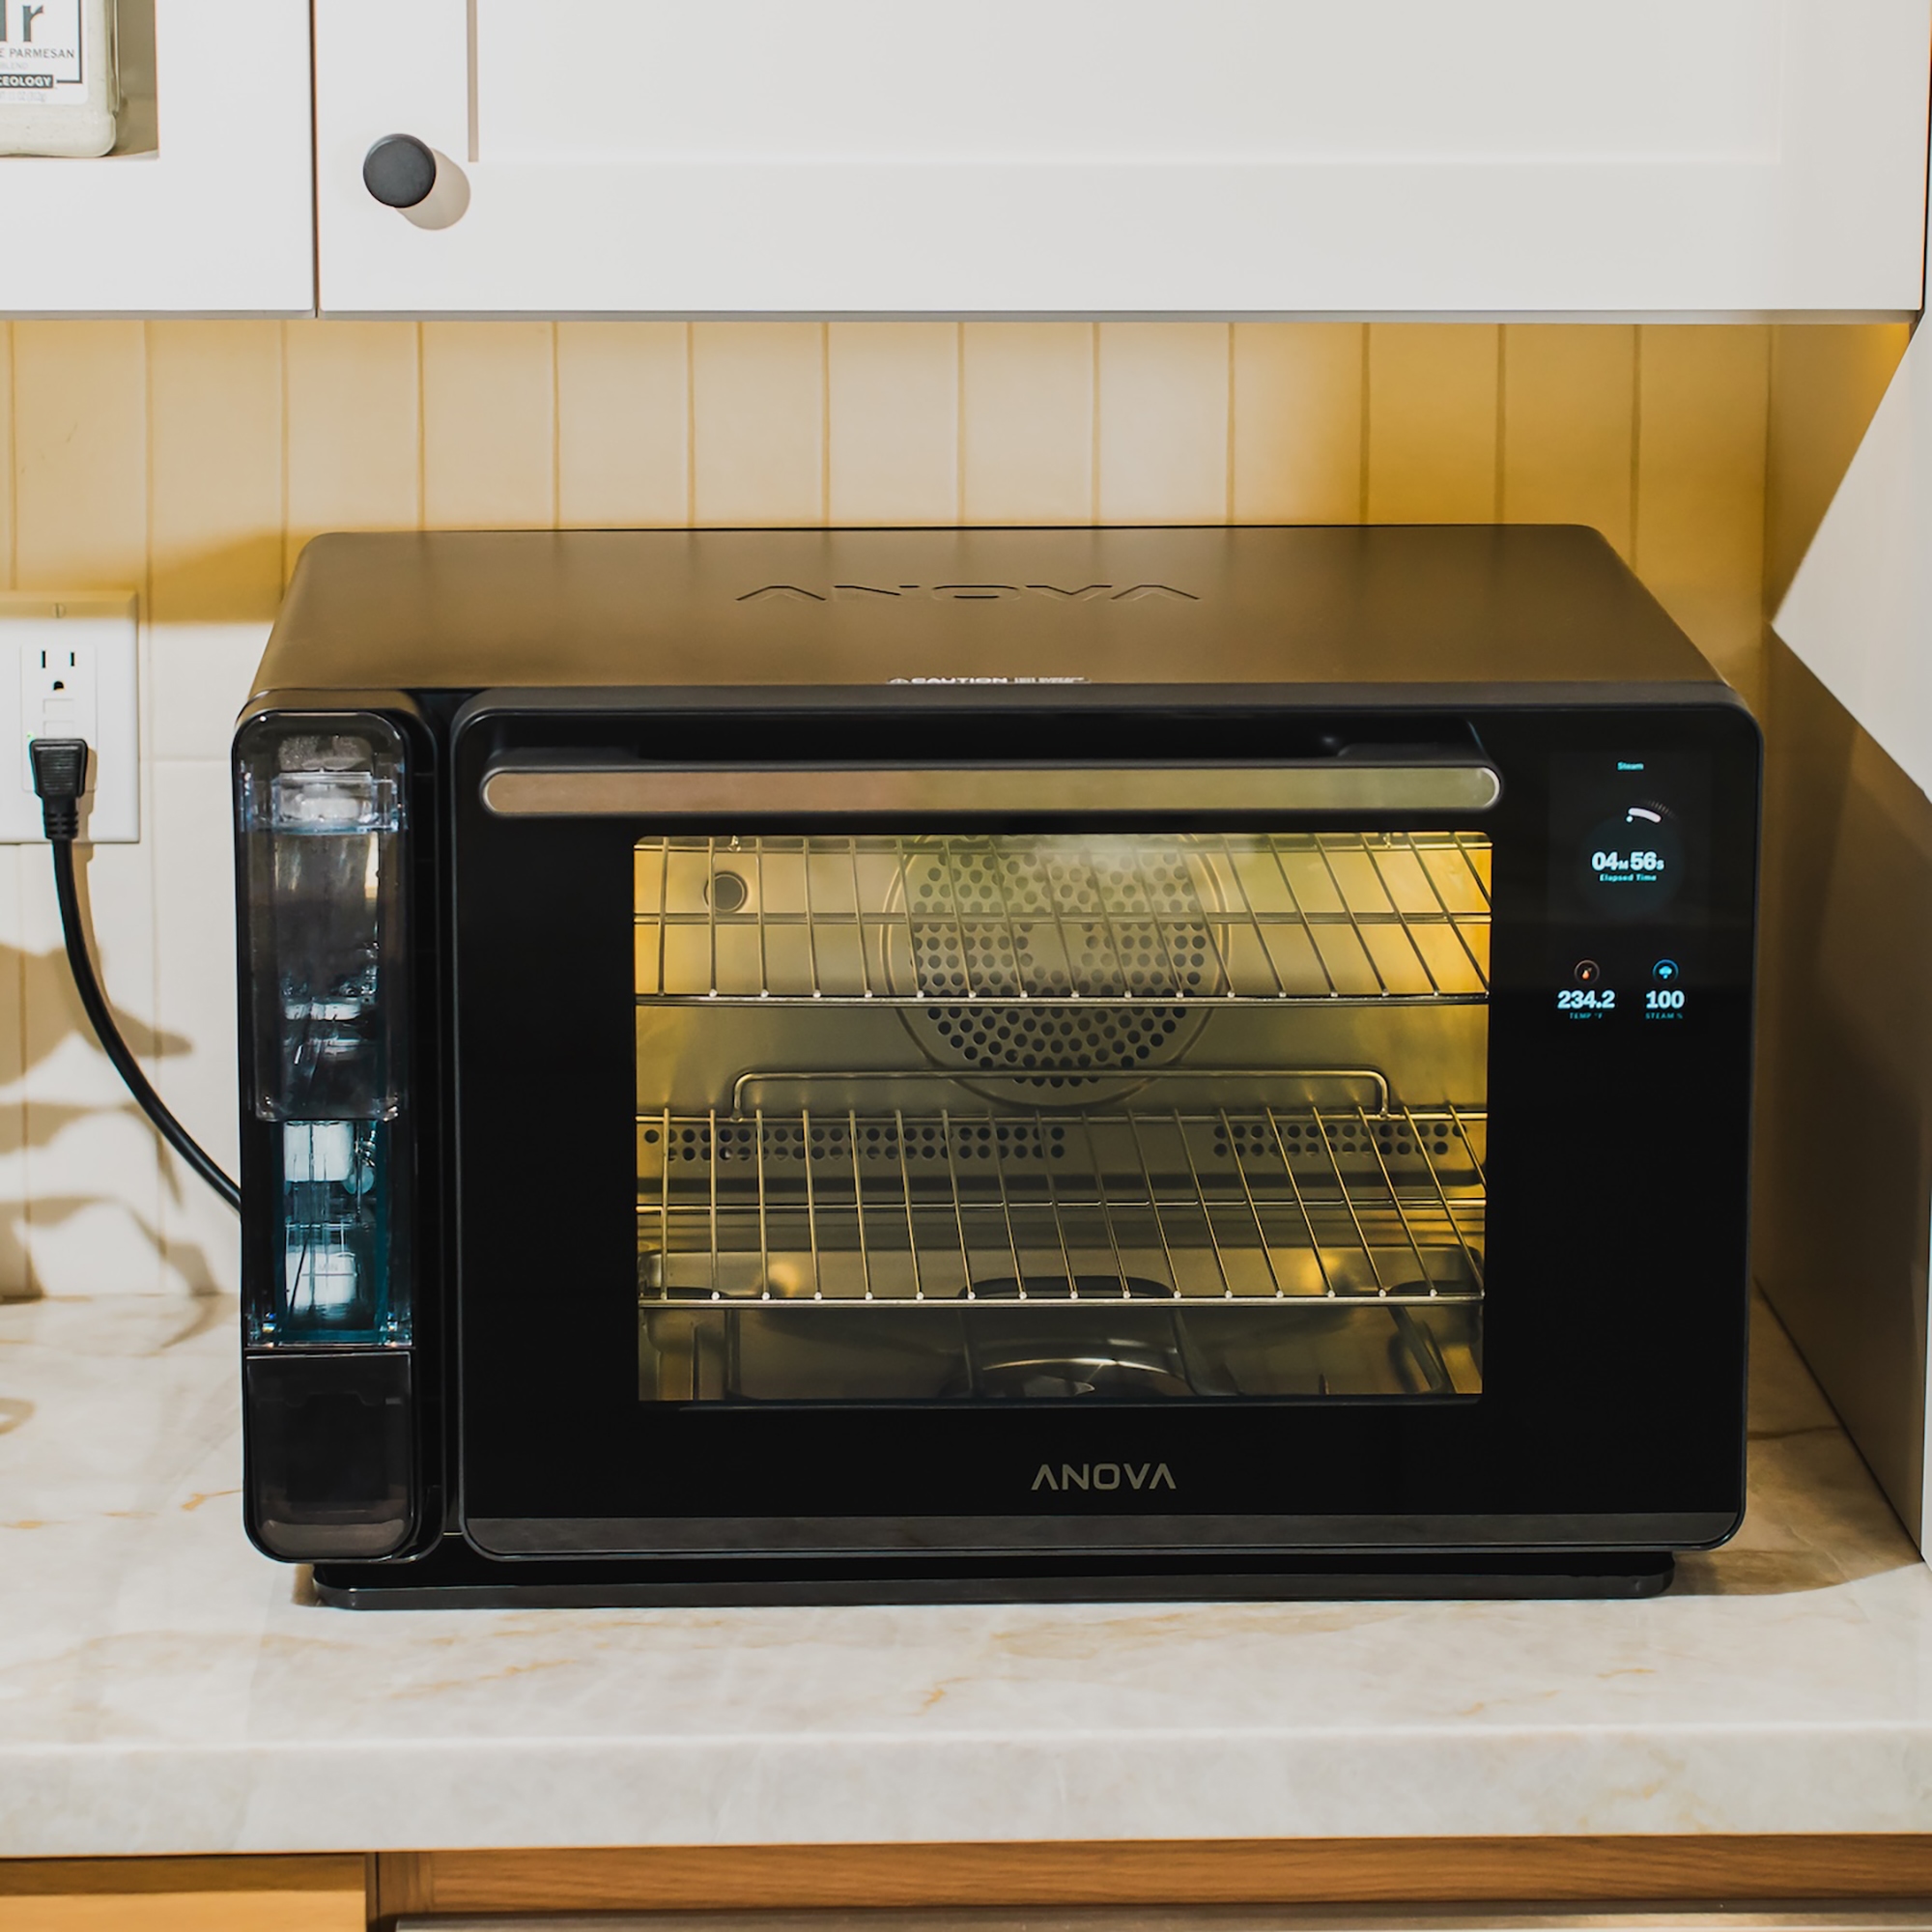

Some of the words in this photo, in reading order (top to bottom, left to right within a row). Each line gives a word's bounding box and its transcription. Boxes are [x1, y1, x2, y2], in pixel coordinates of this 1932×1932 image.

[10, 48, 74, 59] PARMESAN
[735, 584, 1200, 602] ANOVA
[1617, 761, 1644, 771] Steam
[1599, 873, 1634, 882] Elapsed
[1557, 990, 1615, 1009] 234.2
[1645, 990, 1685, 1009] 100
[1031, 1463, 1177, 1491] ANOVA
